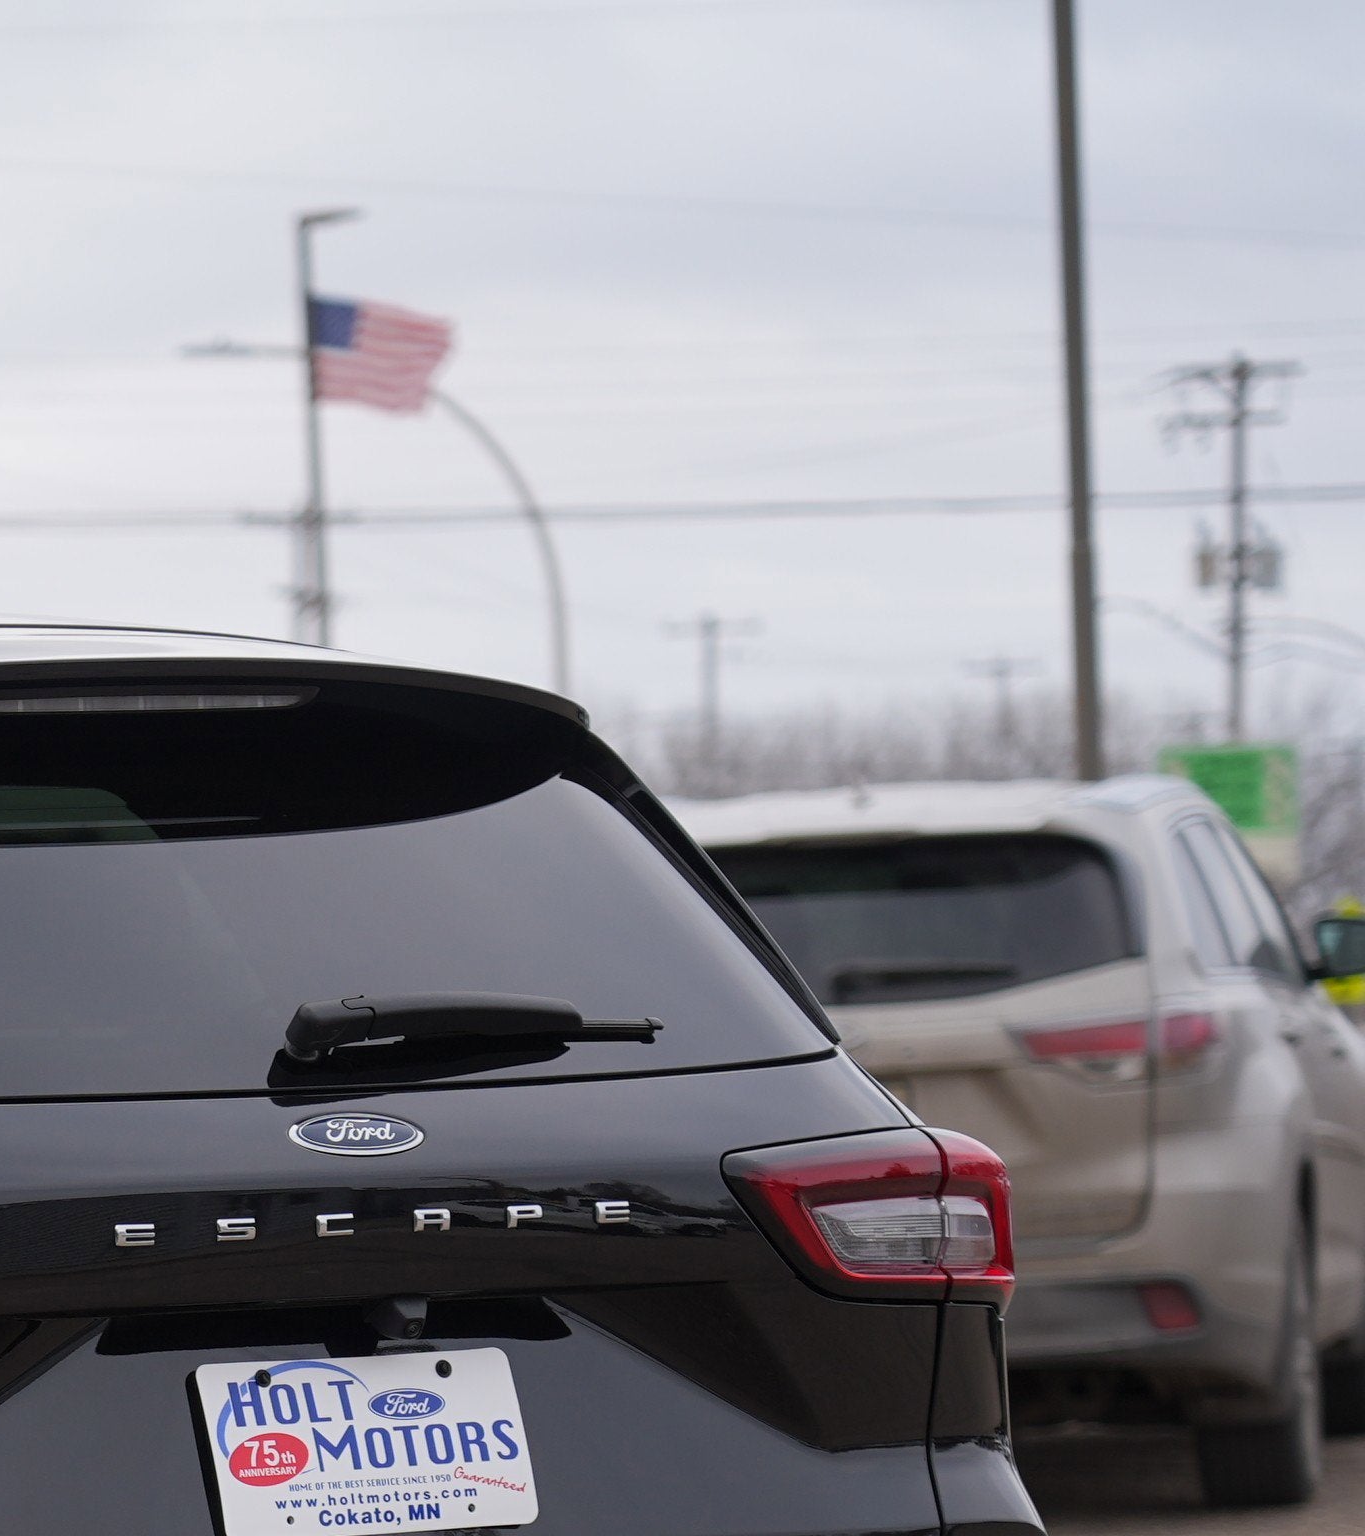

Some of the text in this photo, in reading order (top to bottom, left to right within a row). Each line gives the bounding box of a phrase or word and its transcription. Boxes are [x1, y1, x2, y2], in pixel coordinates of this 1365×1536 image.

[325, 1118, 395, 1142] Ford
[114, 1200, 630, 1247] ESCAPE
[226, 1379, 355, 1428] HOLT
[384, 1392, 431, 1415] Ford
[243, 1439, 297, 1468] 75th
[311, 1419, 519, 1472] MOTORS
[238, 1466, 298, 1478] ANNIVERSARY
[288, 1474, 452, 1492] HOME OF THE BEST SERVICE SINCE 1950
[453, 1466, 527, 1493] Guaranteed
[274, 1486, 478, 1510] www.holtmotors.com
[319, 1502, 441, 1527] Cokato, MN
